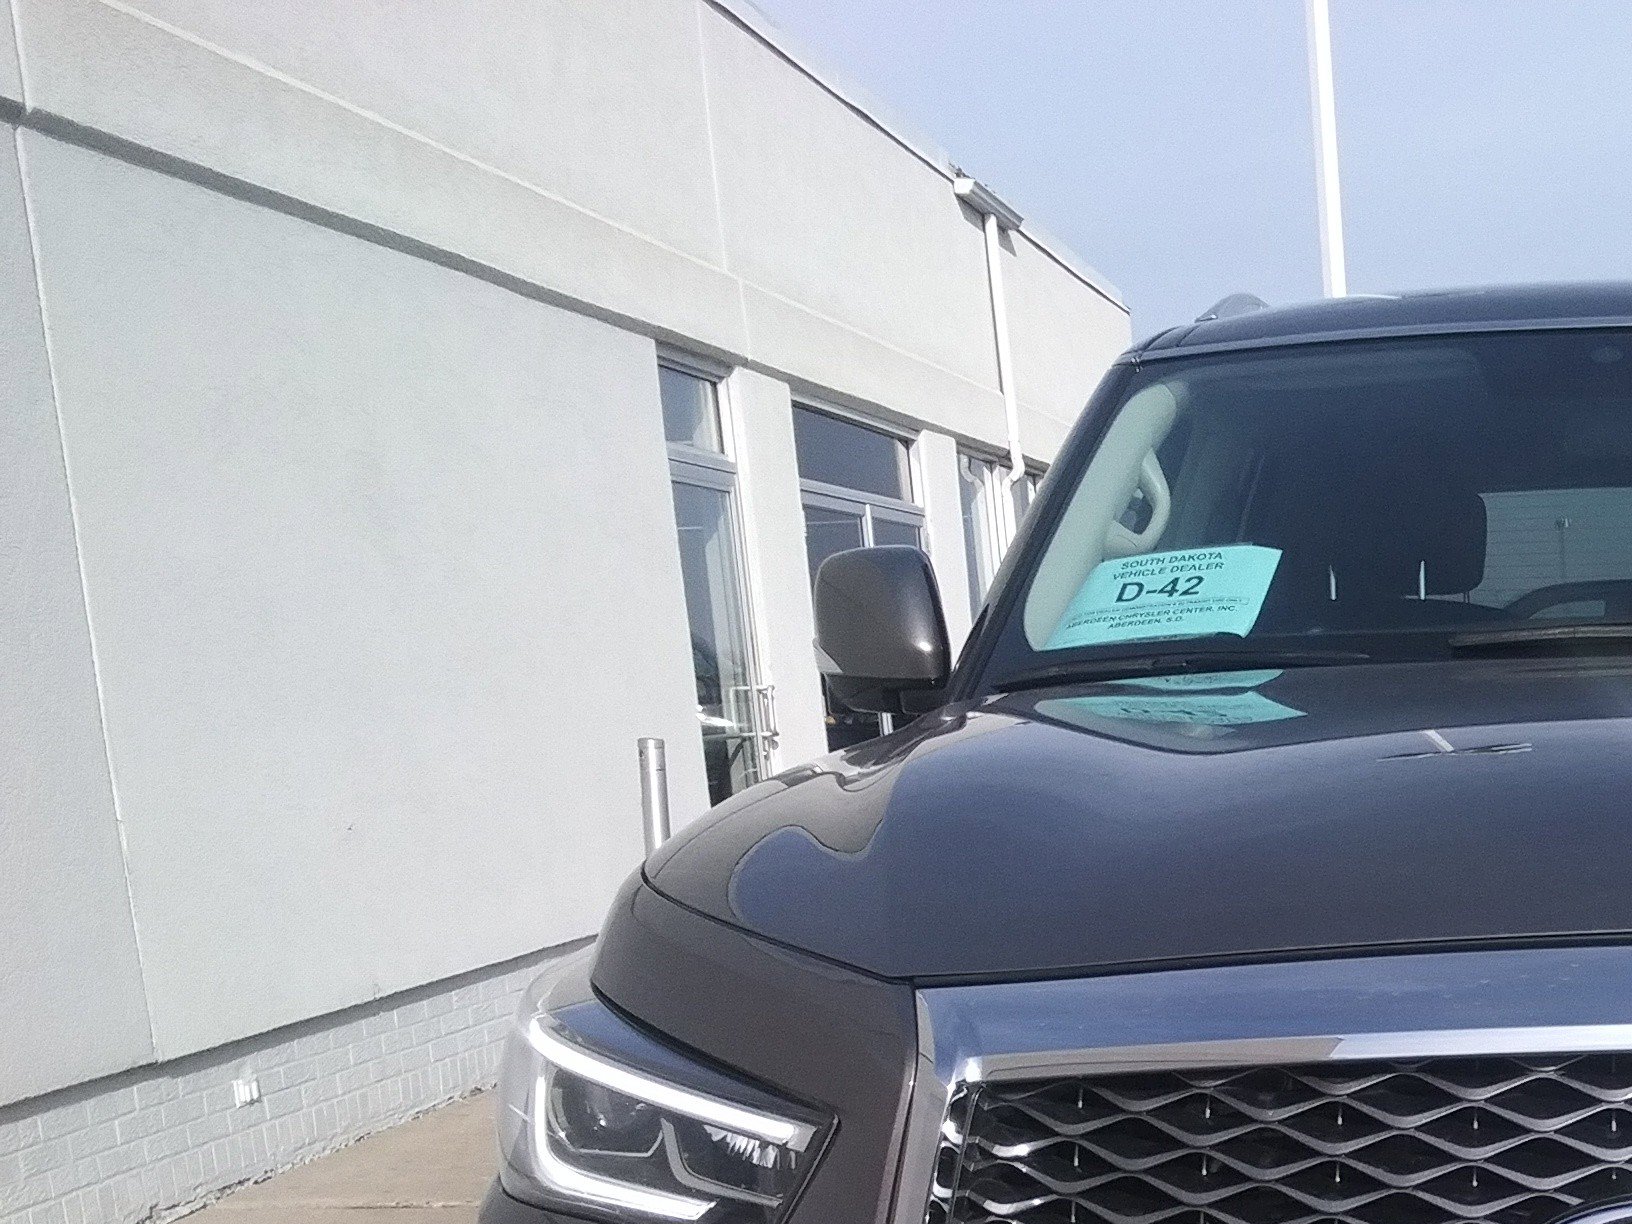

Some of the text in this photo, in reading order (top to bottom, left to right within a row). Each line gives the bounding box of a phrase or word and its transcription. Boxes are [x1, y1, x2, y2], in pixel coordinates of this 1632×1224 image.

[1121, 552, 1223, 570] SOUTH DAKOTA
[1113, 562, 1225, 580] VEHICLE DEALER
[1114, 575, 1205, 603] D-42
